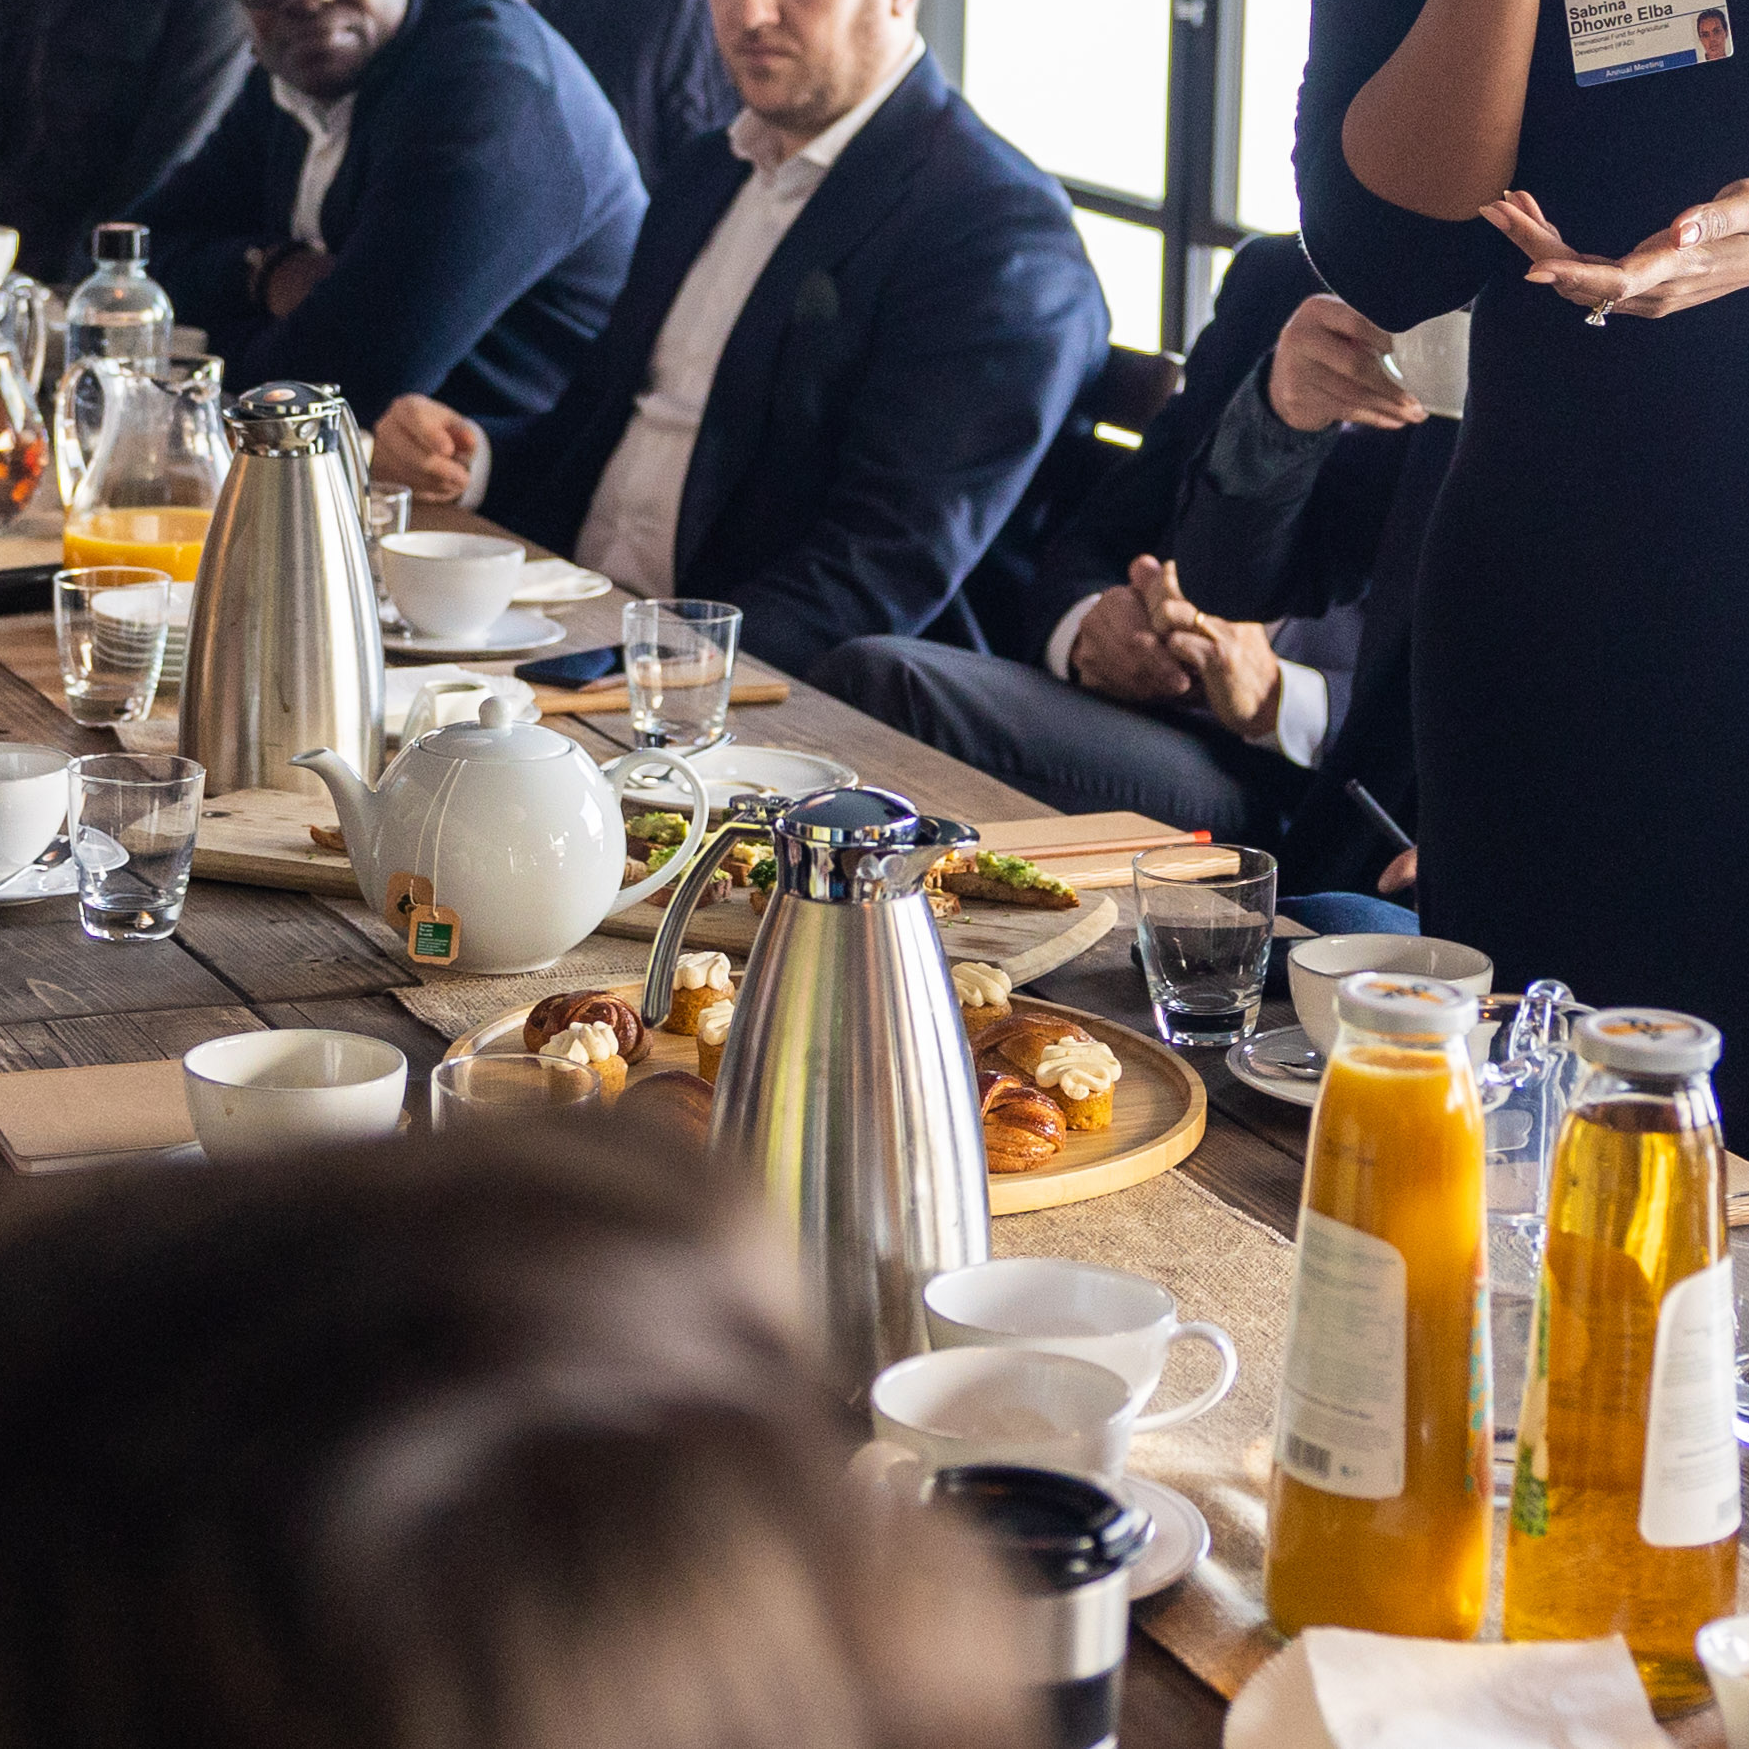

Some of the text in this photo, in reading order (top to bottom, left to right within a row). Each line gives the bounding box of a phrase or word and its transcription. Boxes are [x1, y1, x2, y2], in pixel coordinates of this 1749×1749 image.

[1569, 0, 1626, 20] Sabrina
[1570, 4, 1673, 35] Dhowre Elba
[1606, 60, 1665, 77] Annual Meeting
